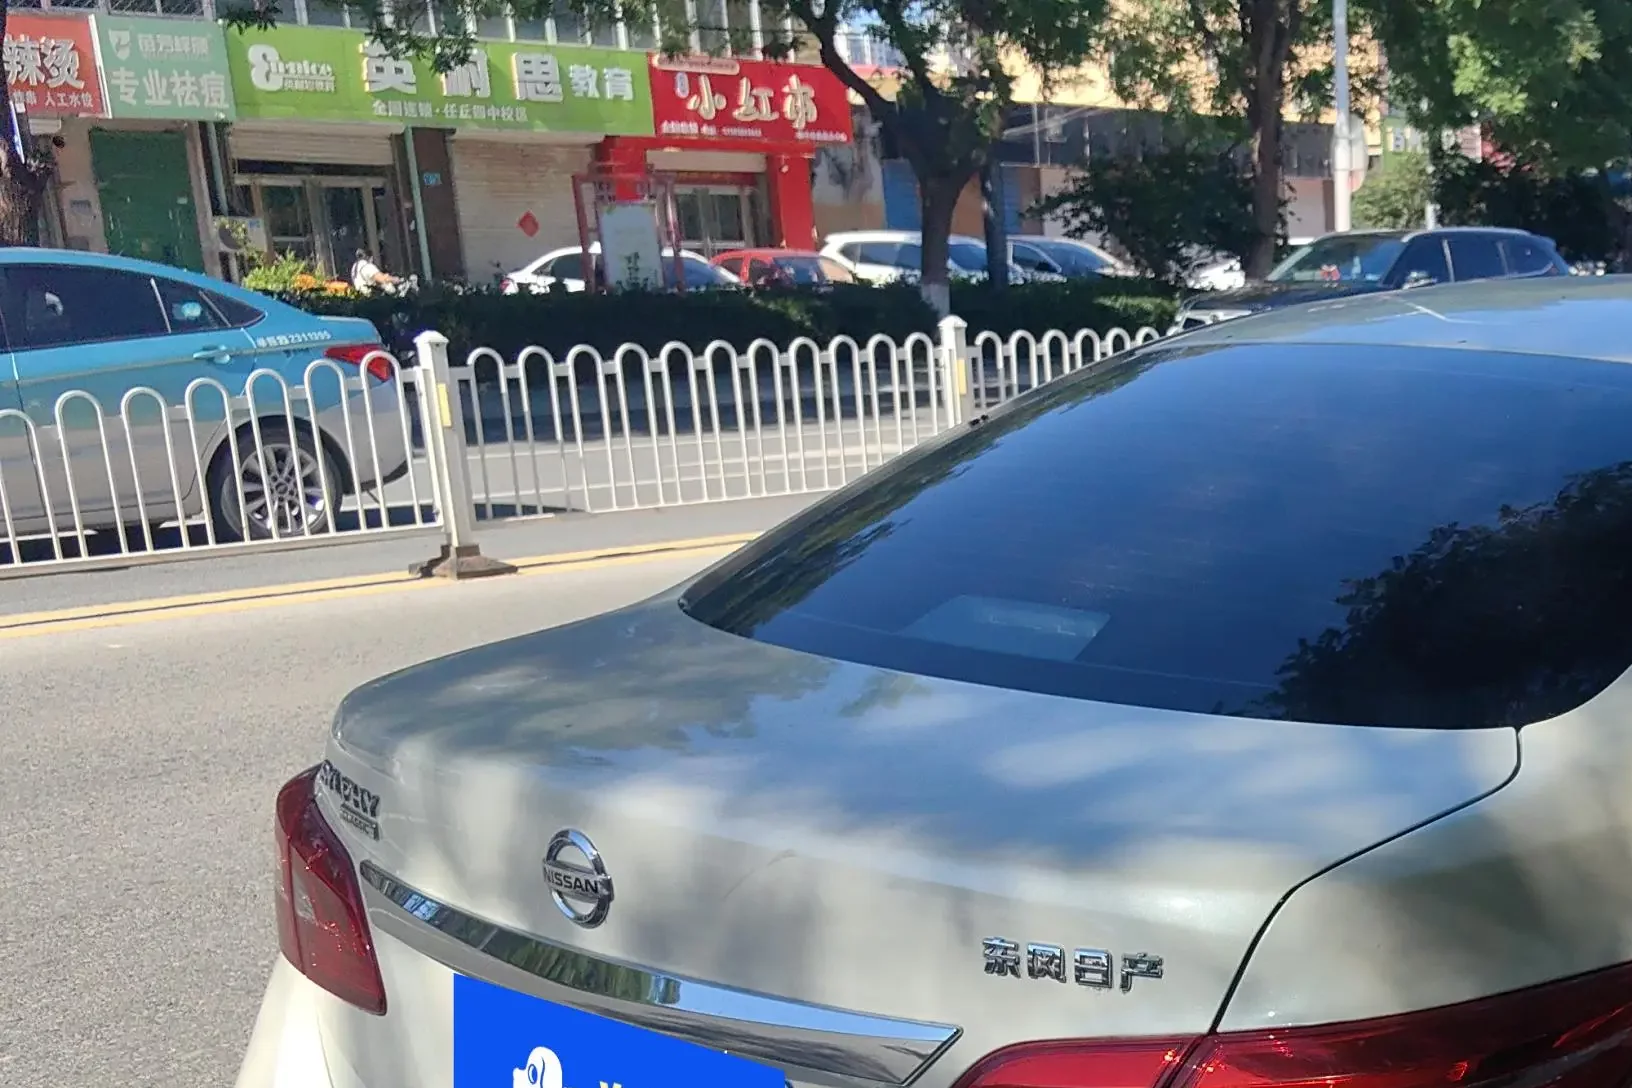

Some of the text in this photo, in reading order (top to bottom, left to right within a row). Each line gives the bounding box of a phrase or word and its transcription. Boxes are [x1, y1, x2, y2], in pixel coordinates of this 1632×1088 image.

[110, 66, 229, 108] 专业祛痘
[543, 864, 599, 894] NISSAN
[982, 937, 1164, 995] 东风日产
